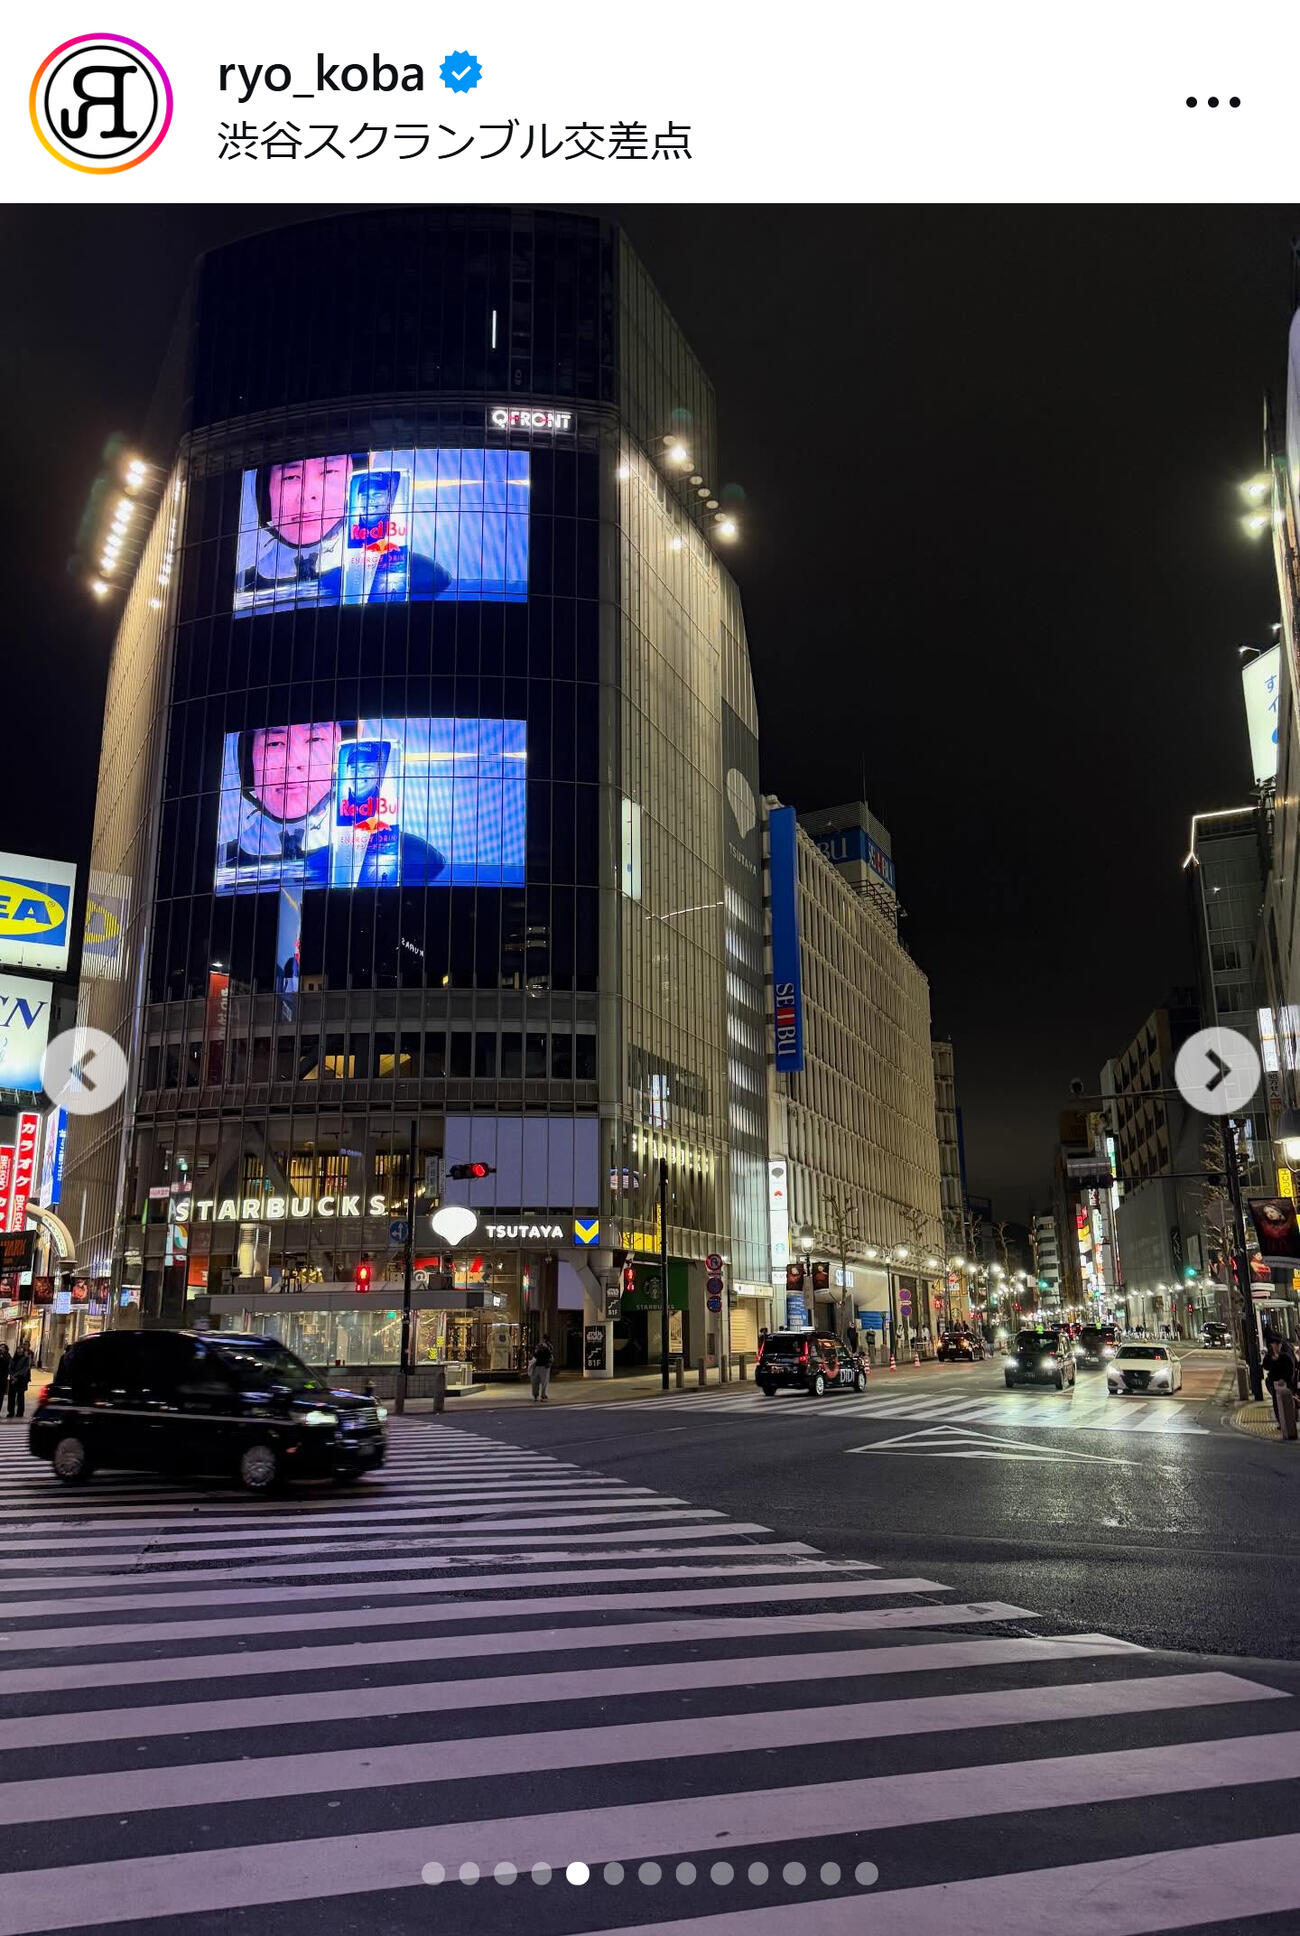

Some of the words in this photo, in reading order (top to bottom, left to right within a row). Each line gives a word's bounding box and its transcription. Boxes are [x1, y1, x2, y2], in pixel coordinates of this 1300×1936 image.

[350, 521, 383, 540] Red
[339, 797, 373, 816] Red
[729, 842, 757, 878] TSUTAYA
[776, 982, 796, 1056] SEIBU
[15, 1122, 36, 1188] カラオケ
[1281, 1170, 1291, 1197] OUCH
[15, 1194, 25, 1211] BIG
[175, 1195, 386, 1222] STARBUCKS
[485, 1225, 564, 1239] TSUTAYA
